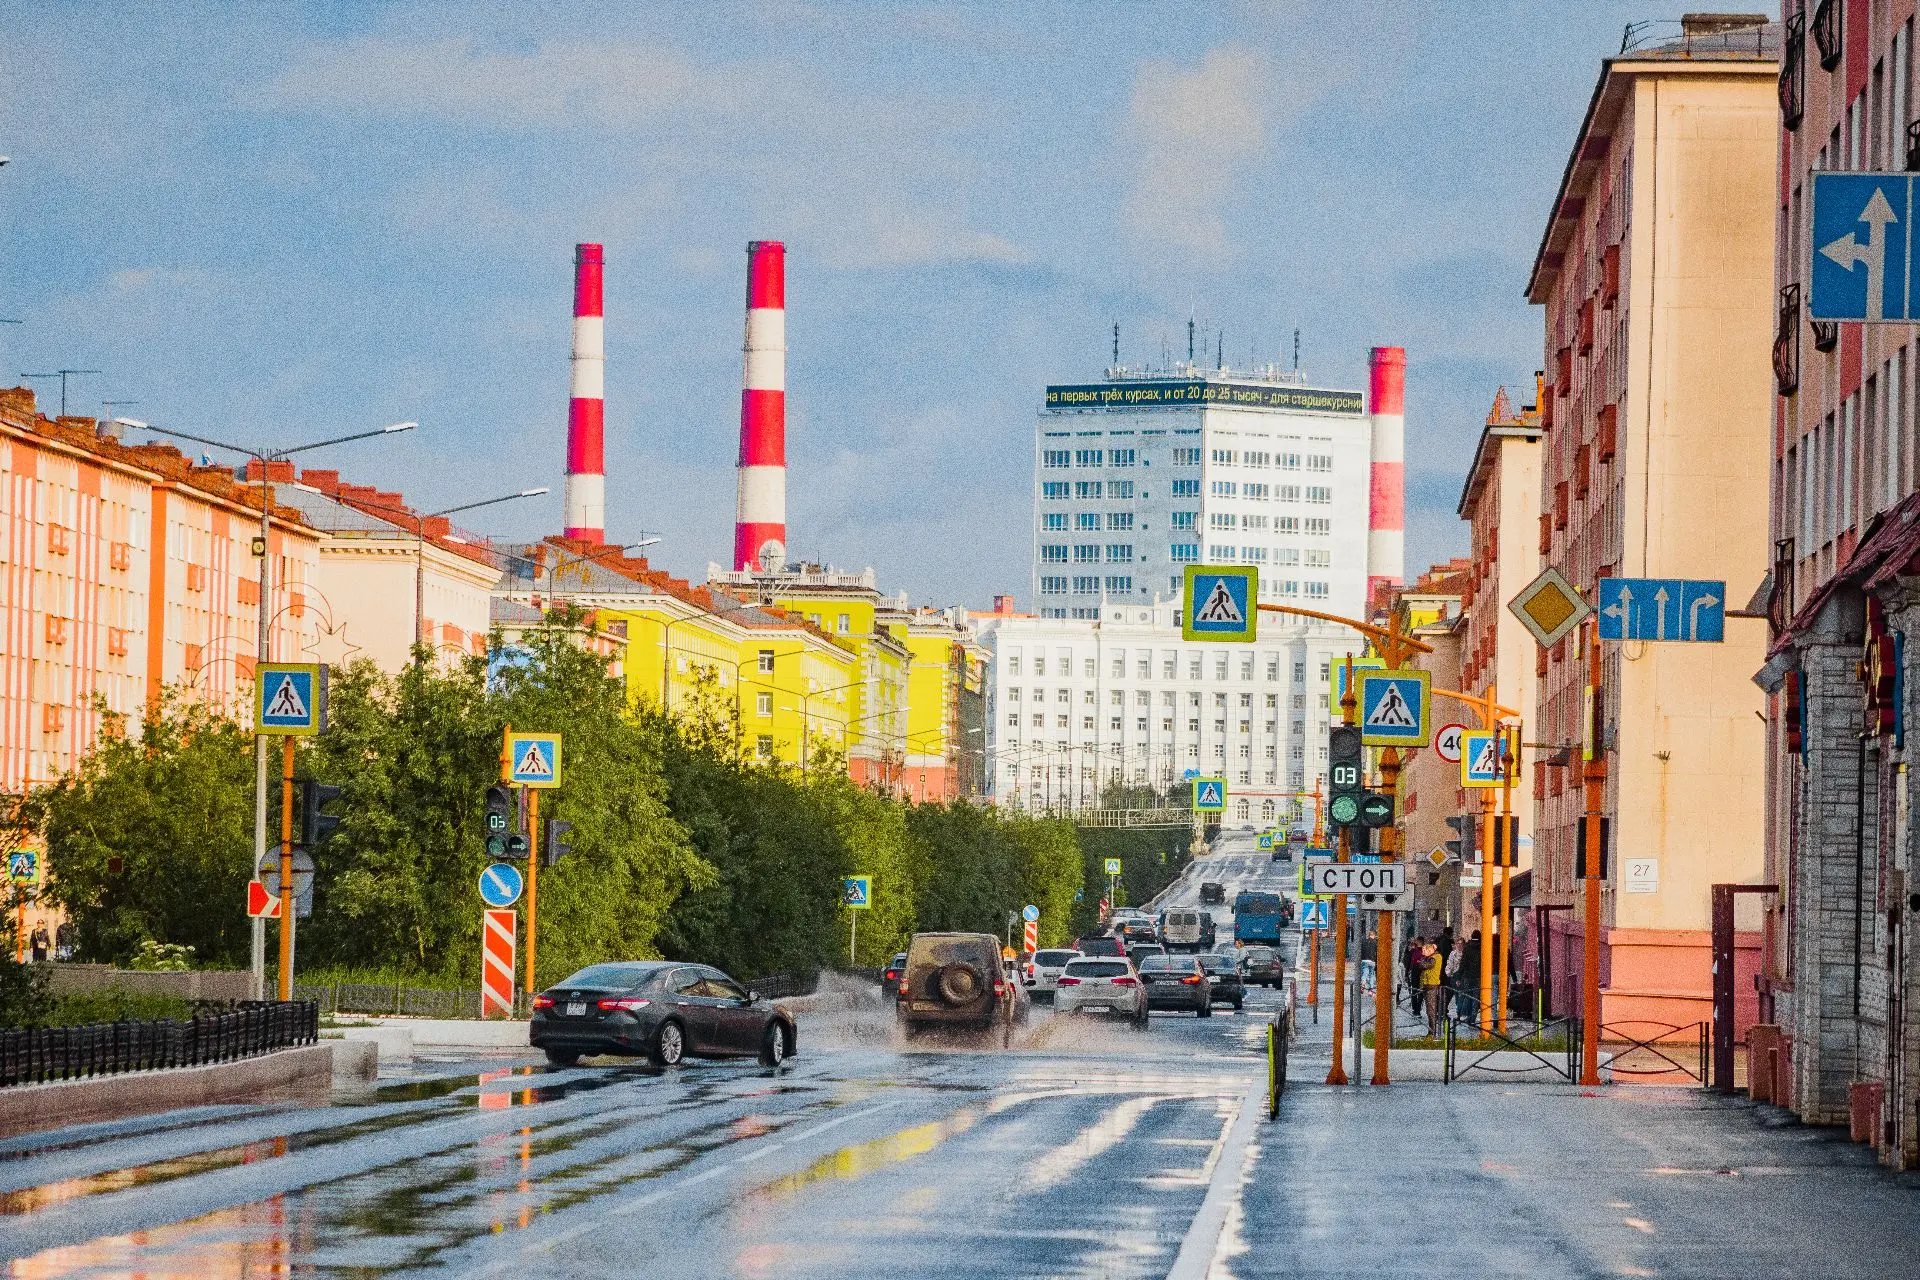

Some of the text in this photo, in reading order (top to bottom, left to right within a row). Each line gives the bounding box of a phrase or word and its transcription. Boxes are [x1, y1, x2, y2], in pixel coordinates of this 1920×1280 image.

[1046, 392, 1058, 402] на
[1061, 391, 1098, 404] первых
[1100, 388, 1122, 403] трёх
[1125, 388, 1161, 403] курсах,
[1165, 389, 1171, 399] и
[1173, 389, 1185, 399] от
[1187, 386, 1200, 399] 20
[1202, 388, 1215, 400] до
[1218, 387, 1230, 400] 25
[1232, 390, 1262, 403] тысяч
[1270, 392, 1289, 405] для
[1334, 767, 1356, 784] 03
[1323, 869, 1394, 888] СТОП
[1633, 864, 1650, 876] 27
